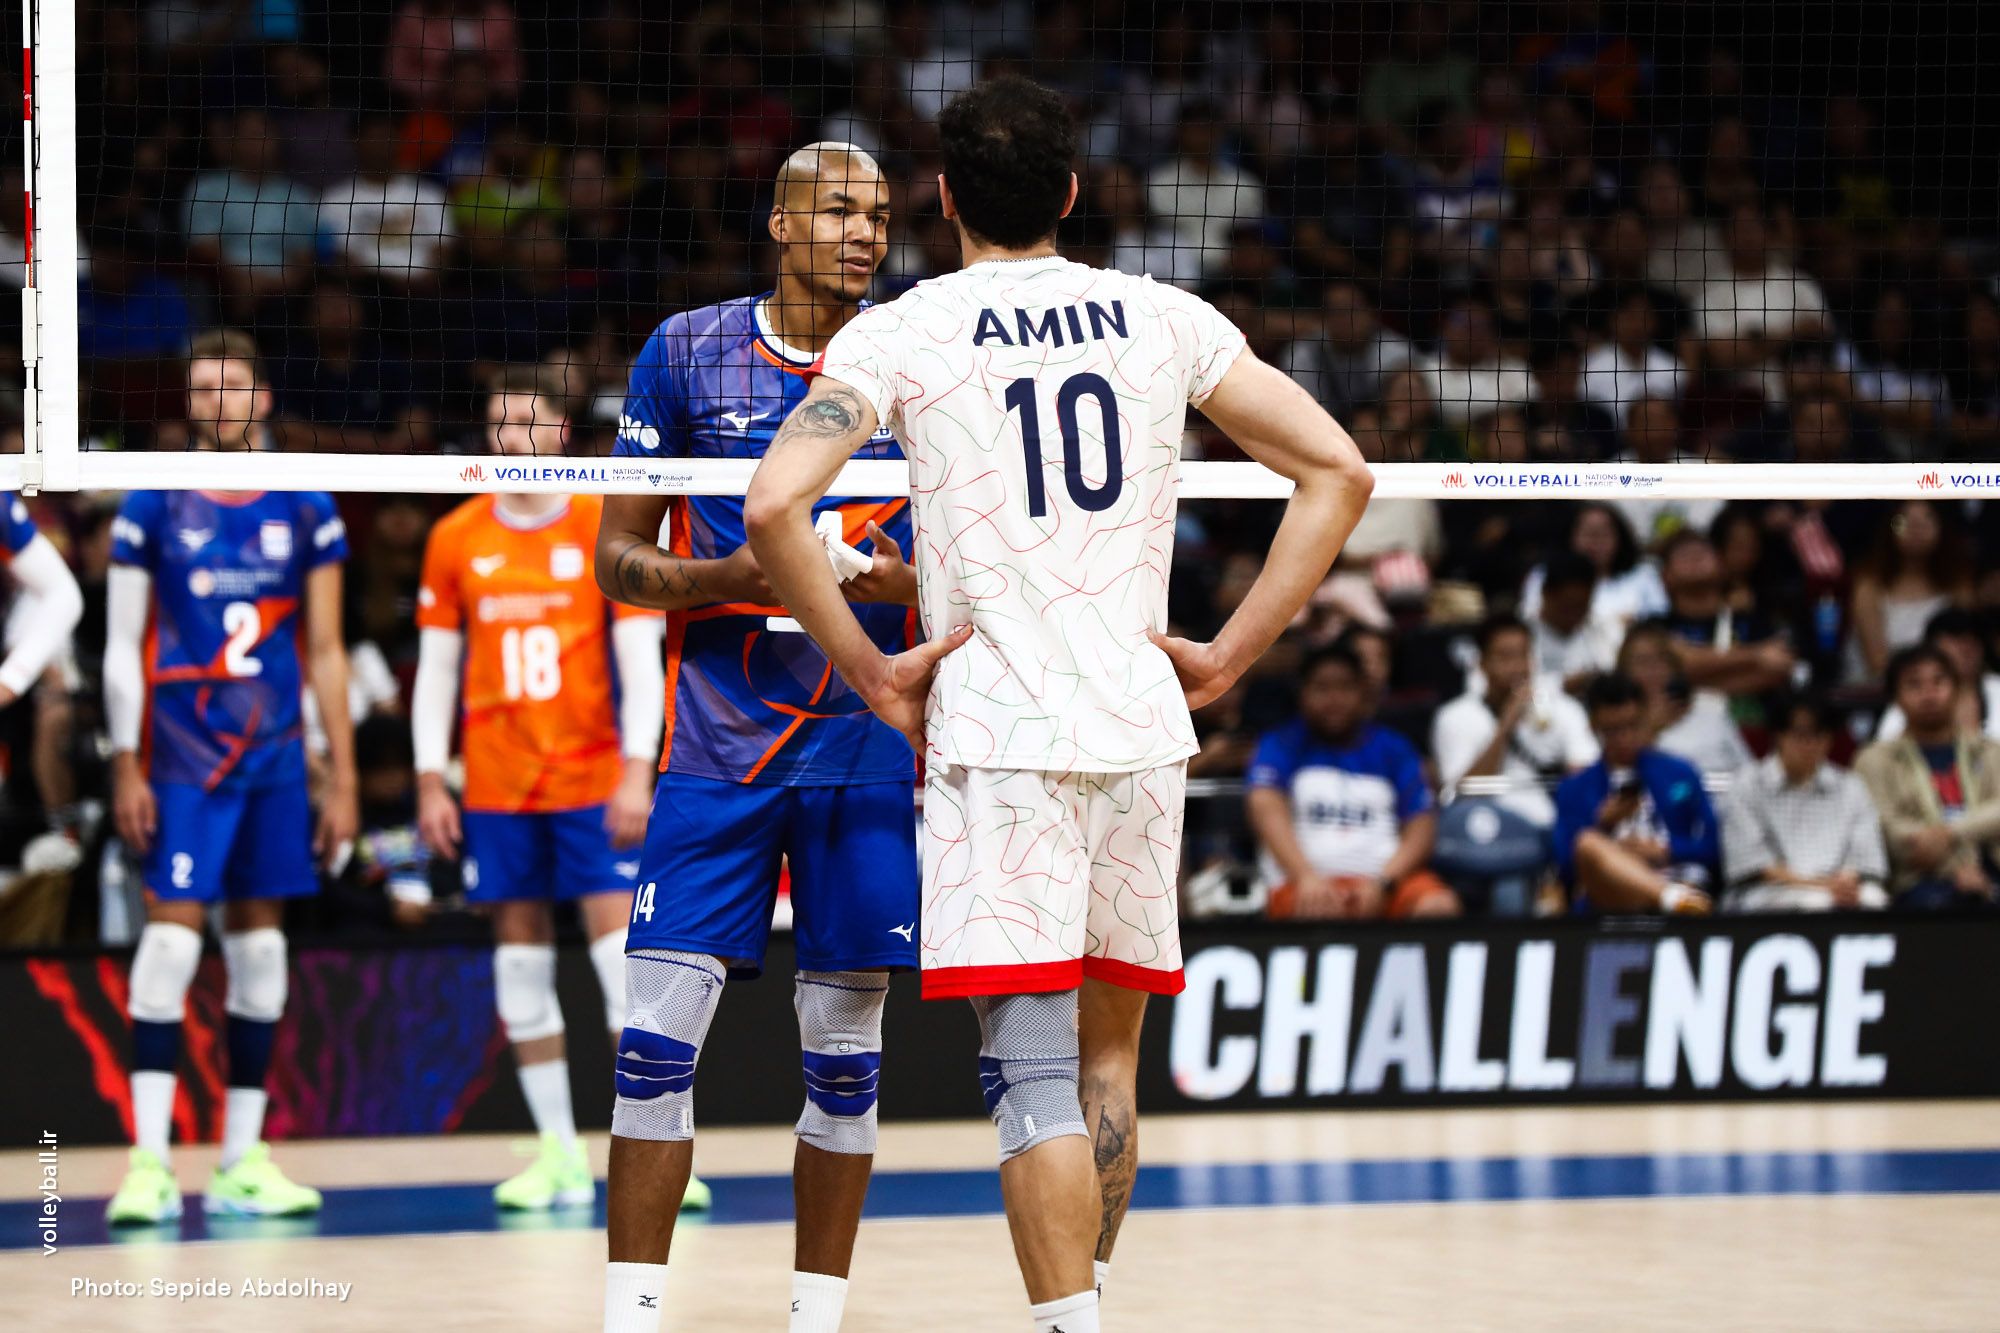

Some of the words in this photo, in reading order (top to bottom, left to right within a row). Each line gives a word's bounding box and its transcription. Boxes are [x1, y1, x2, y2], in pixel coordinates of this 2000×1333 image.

[973, 300, 1129, 348] AMIN
[1005, 372, 1123, 518] 10
[494, 467, 610, 482] VOLLEYBALL
[1473, 474, 1582, 488] VOLLEYBALL
[1585, 473, 1618, 481] NATIONS
[222, 600, 264, 678] 2
[501, 625, 562, 701] 18
[171, 851, 195, 890] 2
[632, 882, 657, 924] 14
[1169, 934, 1897, 1100] CHALLENGE
